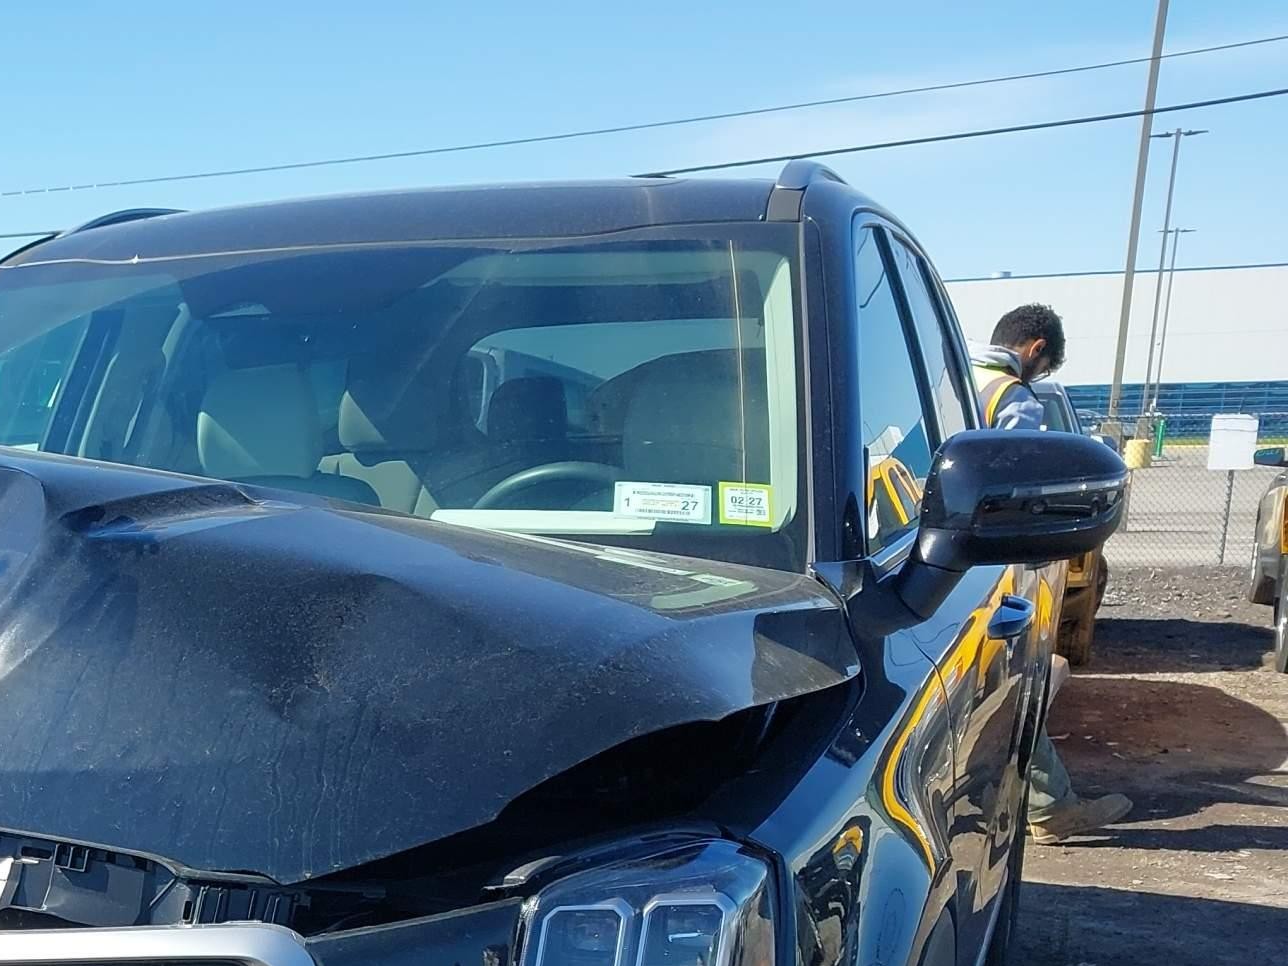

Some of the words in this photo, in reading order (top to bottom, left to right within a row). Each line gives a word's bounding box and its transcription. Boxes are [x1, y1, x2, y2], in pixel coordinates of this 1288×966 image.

[624, 497, 630, 507] 1
[681, 501, 698, 511] 27
[730, 496, 744, 504] 02
[748, 497, 762, 506] 27
